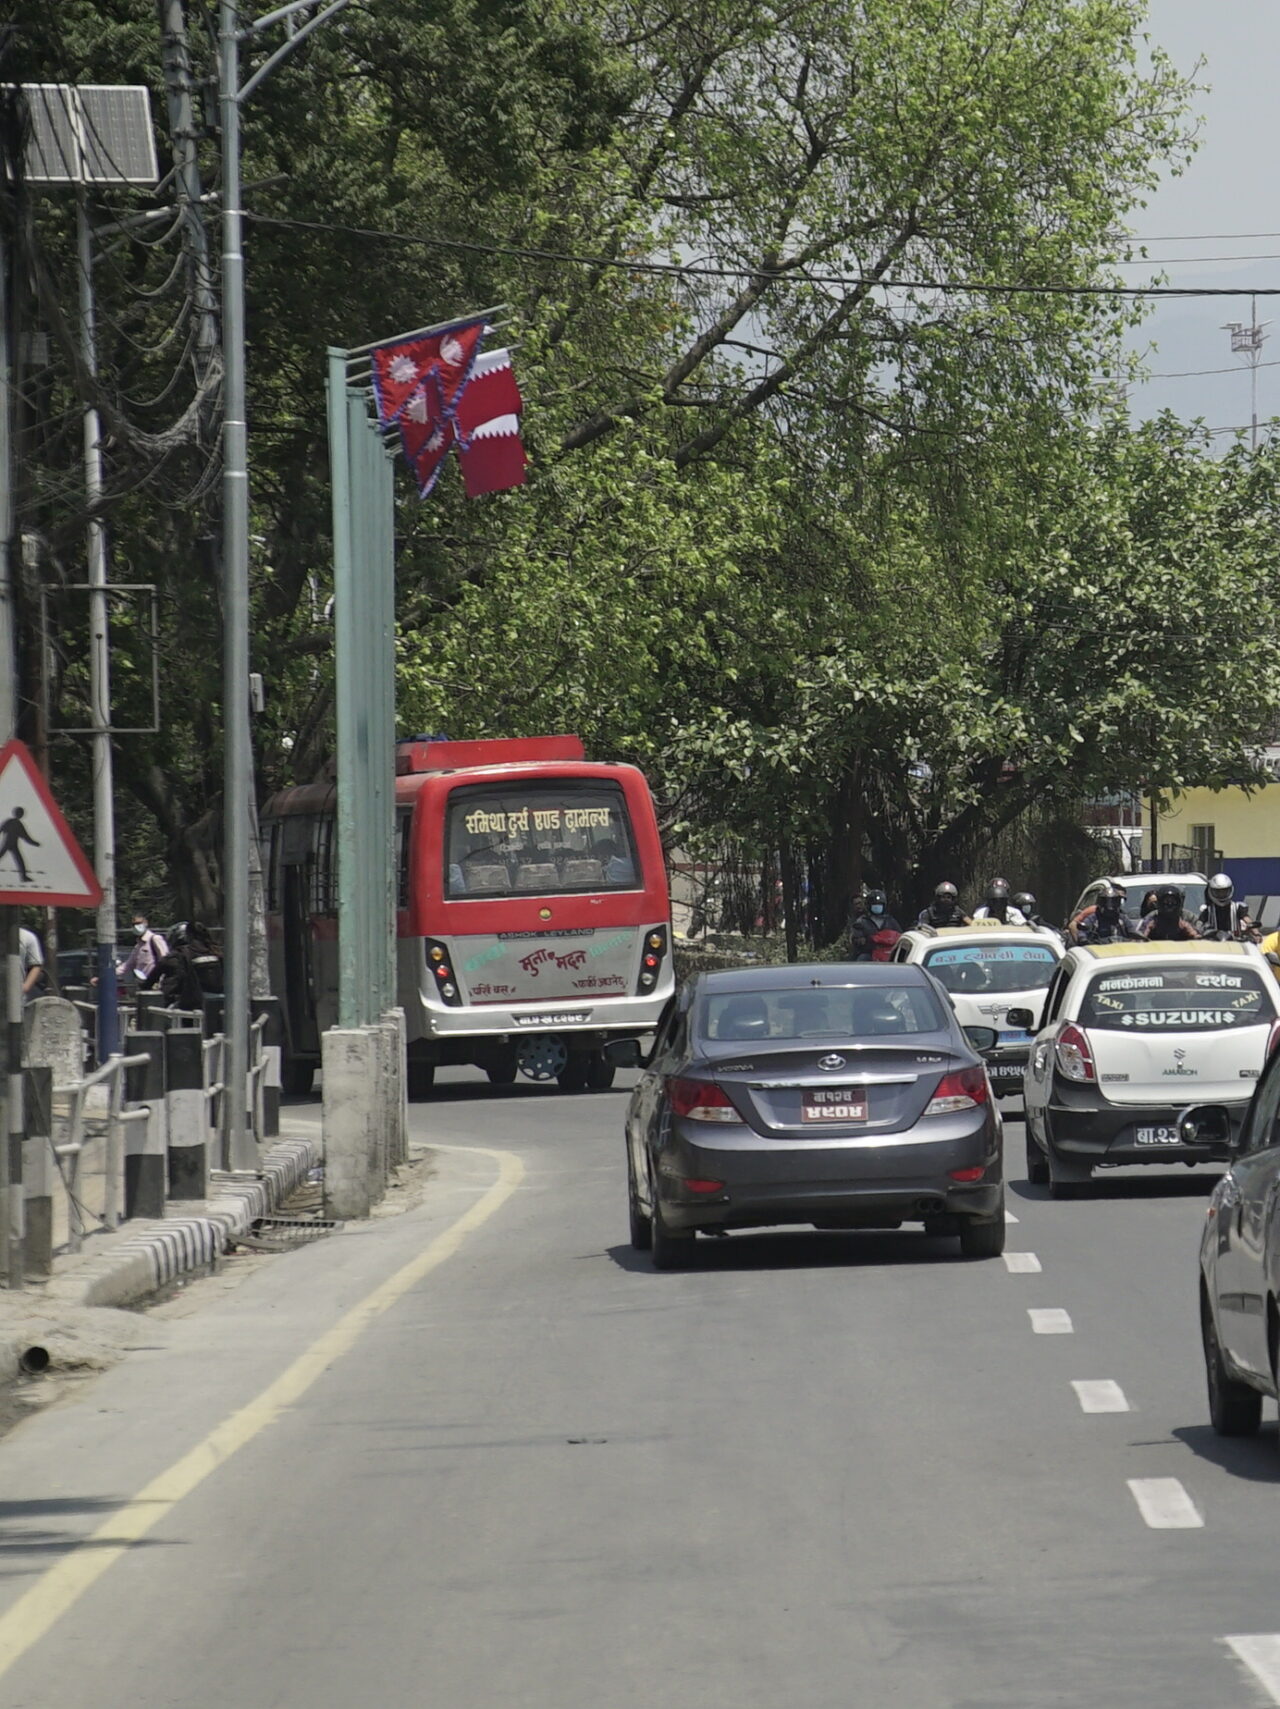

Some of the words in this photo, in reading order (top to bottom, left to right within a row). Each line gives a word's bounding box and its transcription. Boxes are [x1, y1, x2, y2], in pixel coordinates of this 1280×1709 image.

[533, 810, 560, 831] एण्ड
[501, 931, 537, 939] ASHOK
[544, 928, 594, 937] LEYLAND
[1099, 976, 1164, 991] मनकामना
[1195, 974, 1242, 988] दर्शन
[1097, 994, 1124, 1010] TAXI
[1232, 991, 1259, 1008] TAXI
[1135, 1011, 1222, 1025] SUZUKI
